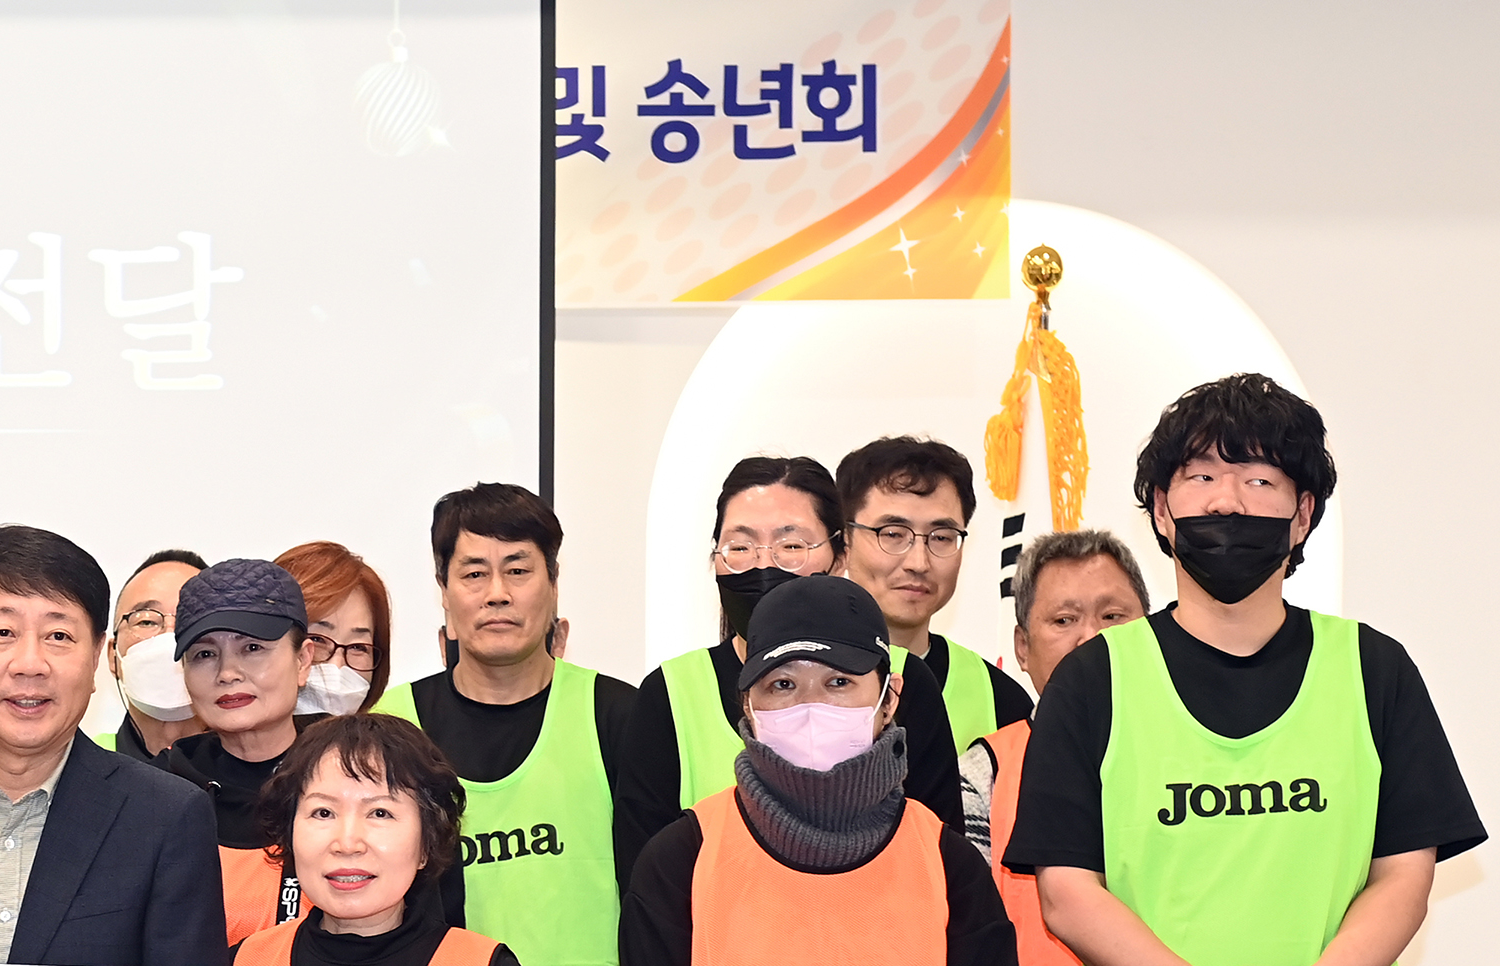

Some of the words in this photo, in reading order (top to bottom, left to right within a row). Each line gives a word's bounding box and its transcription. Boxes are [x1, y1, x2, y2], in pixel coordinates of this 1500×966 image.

[638, 59, 878, 164] 송년회
[1157, 778, 1328, 826] Joma
[460, 823, 564, 867] oma
